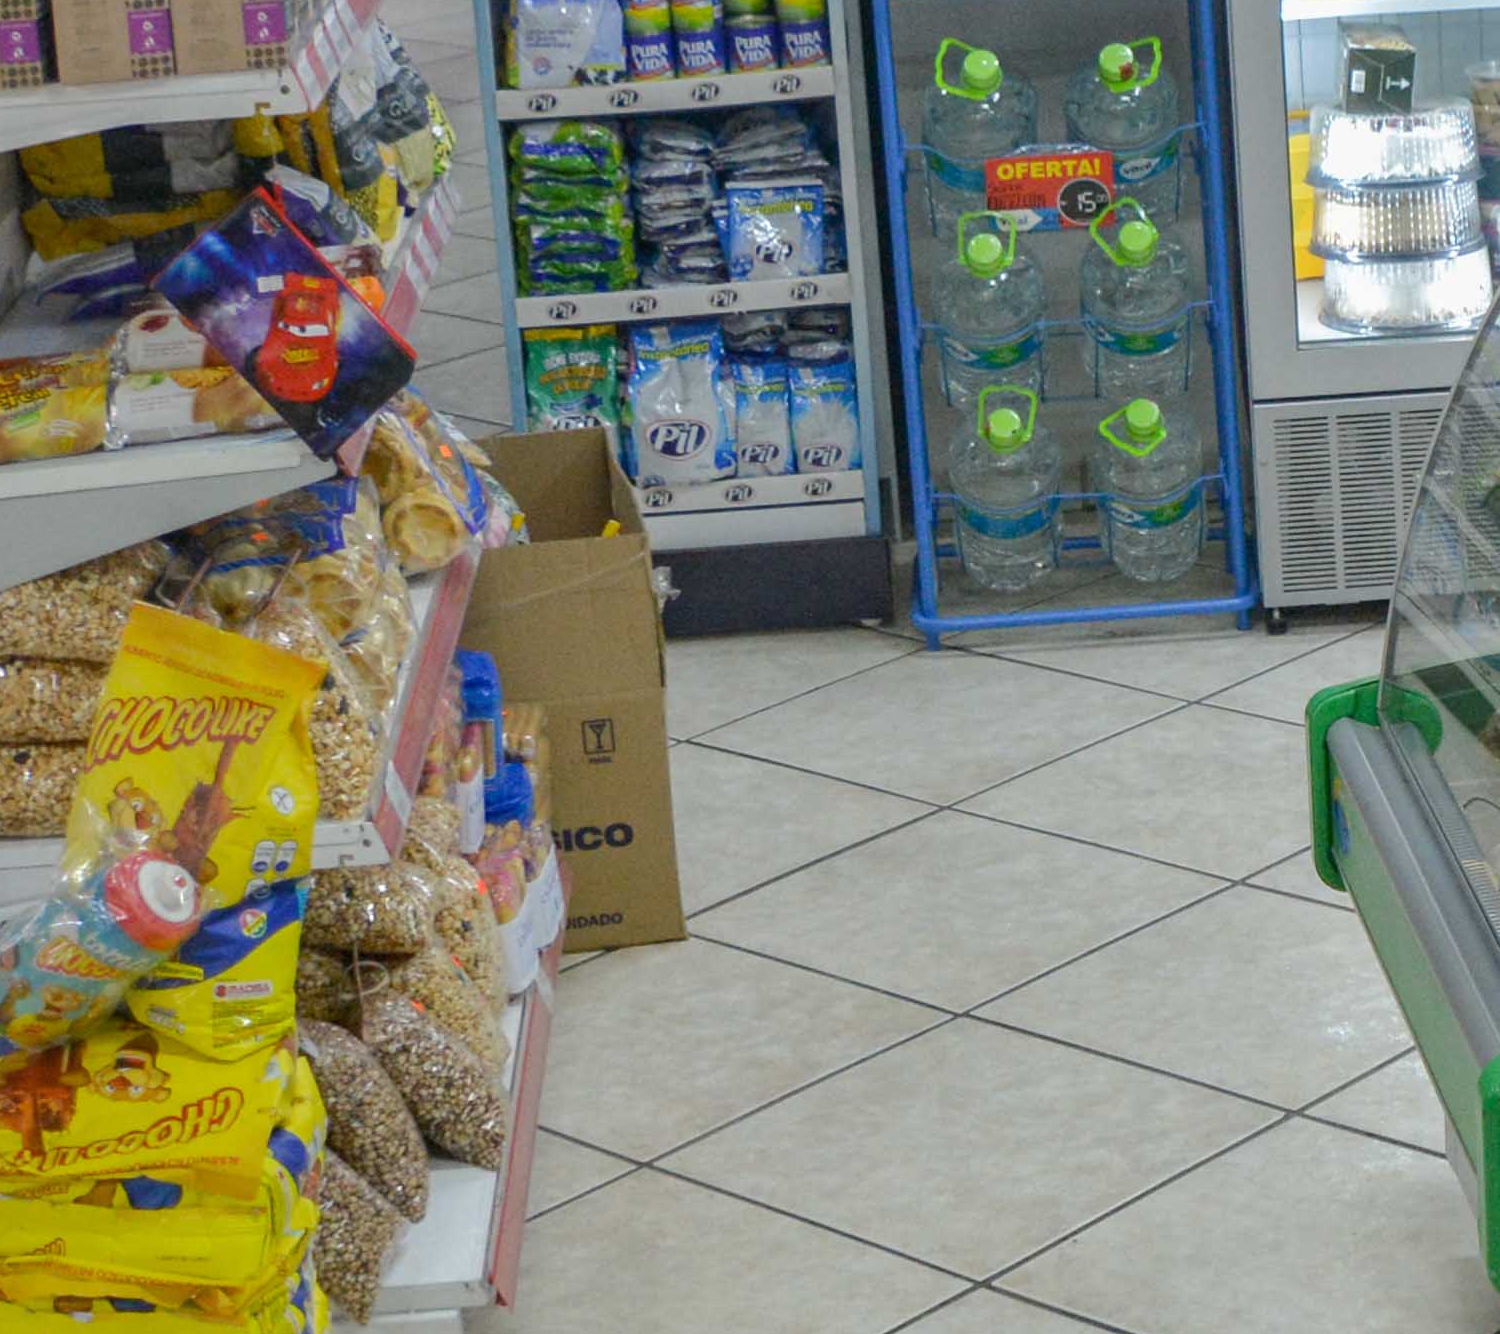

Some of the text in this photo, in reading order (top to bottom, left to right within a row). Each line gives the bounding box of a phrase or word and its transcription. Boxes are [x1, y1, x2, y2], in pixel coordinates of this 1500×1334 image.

[629, 39, 668, 57] PURA
[677, 36, 717, 52] PURA
[633, 53, 669, 71] VIDA
[681, 50, 718, 68] VIDA
[996, 158, 1102, 180] OFERTA!
[651, 425, 706, 459] Pil
[87, 697, 277, 769] CHOCOLIKE
